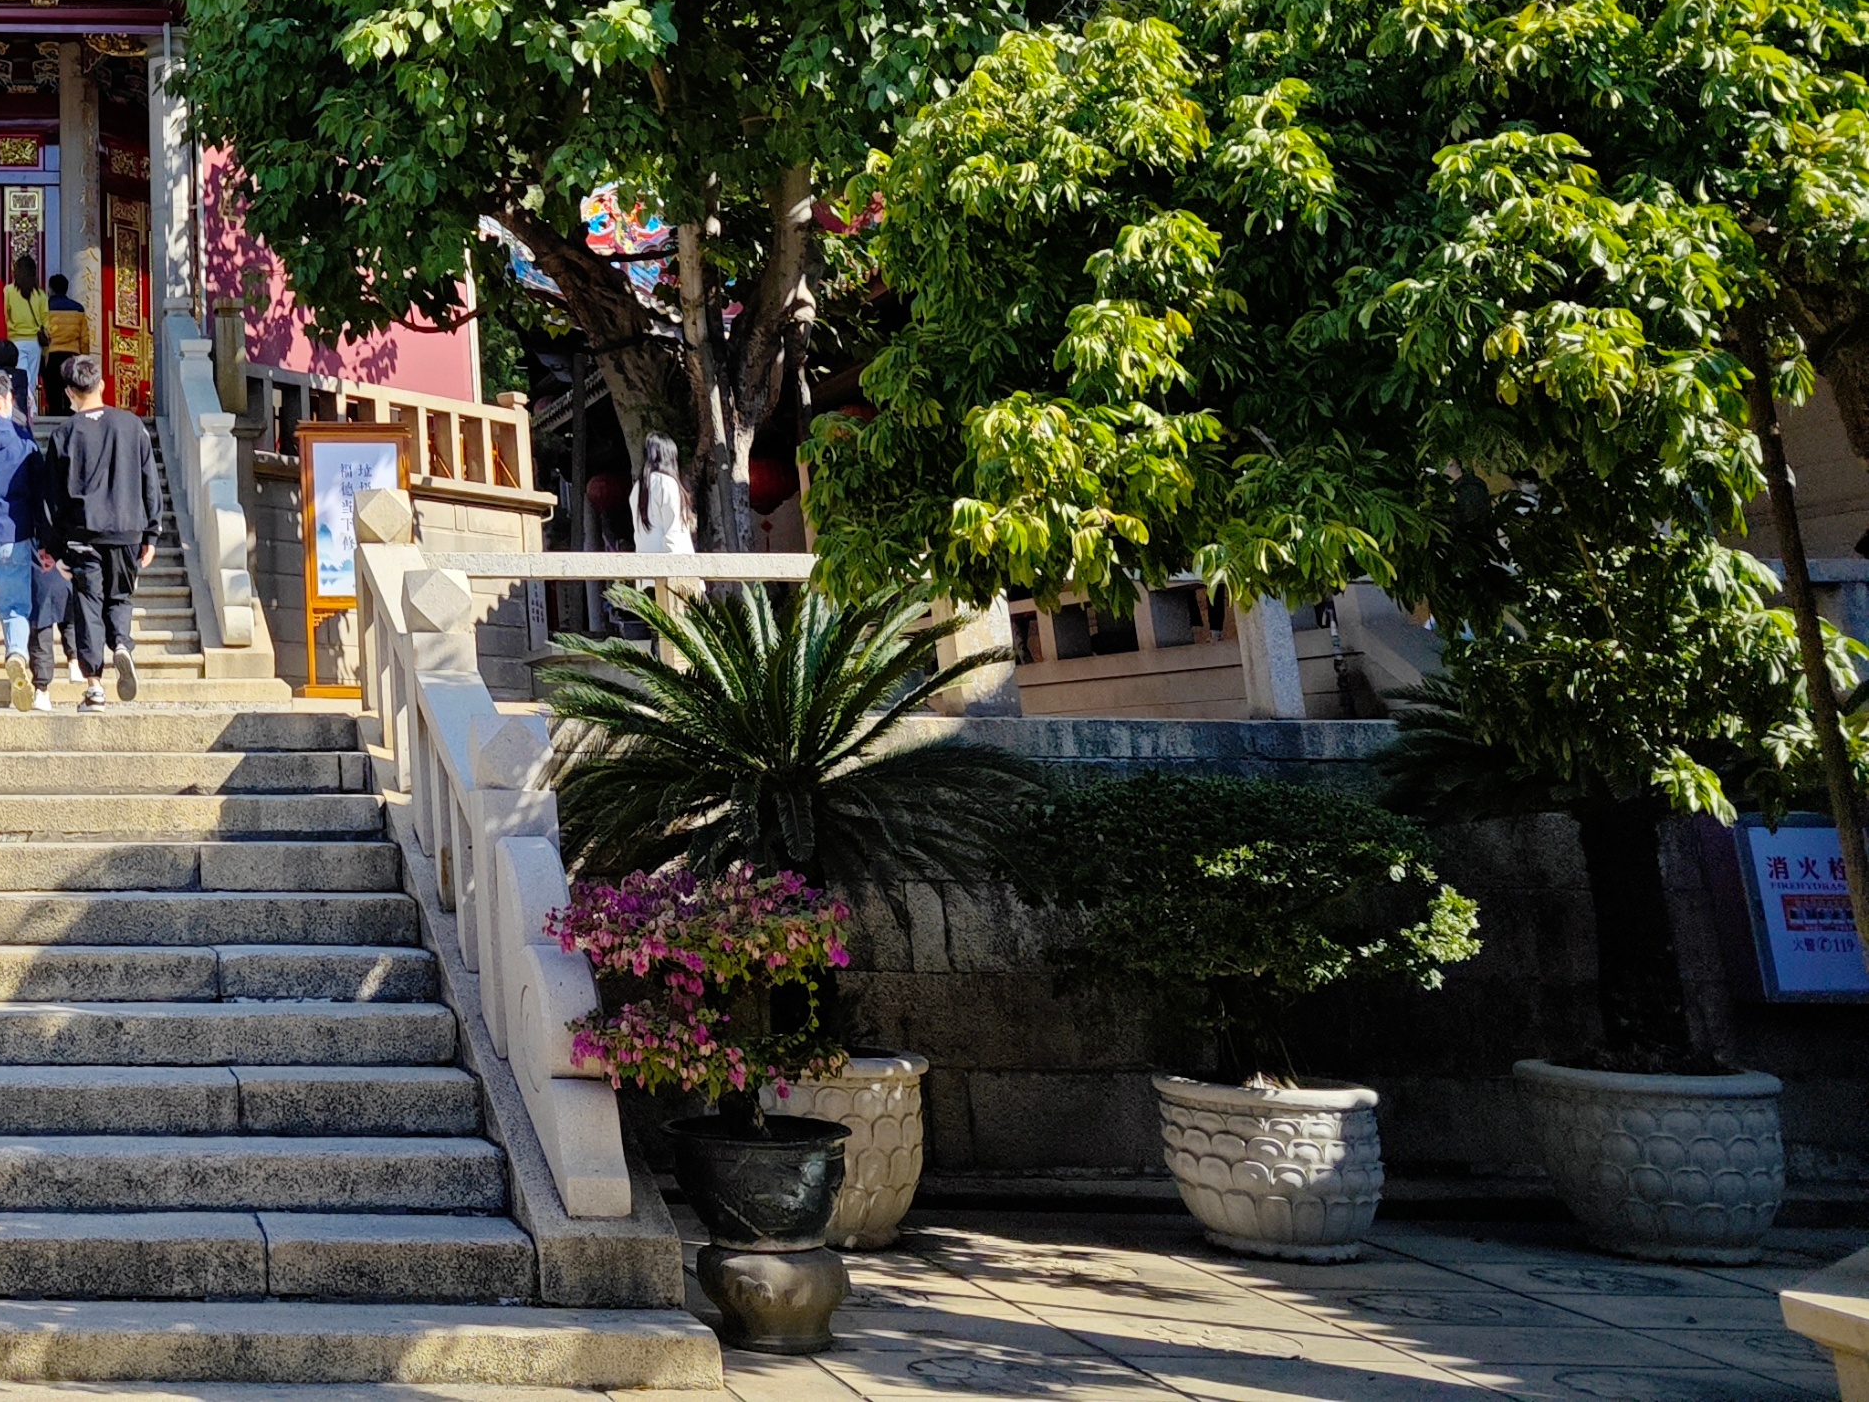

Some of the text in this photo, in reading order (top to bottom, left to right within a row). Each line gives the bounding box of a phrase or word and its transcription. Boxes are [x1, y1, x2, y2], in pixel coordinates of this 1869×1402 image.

[339, 463, 356, 551] 福德当下修
[1766, 855, 1847, 880] 消火栓
[1834, 938, 1855, 953] 119
